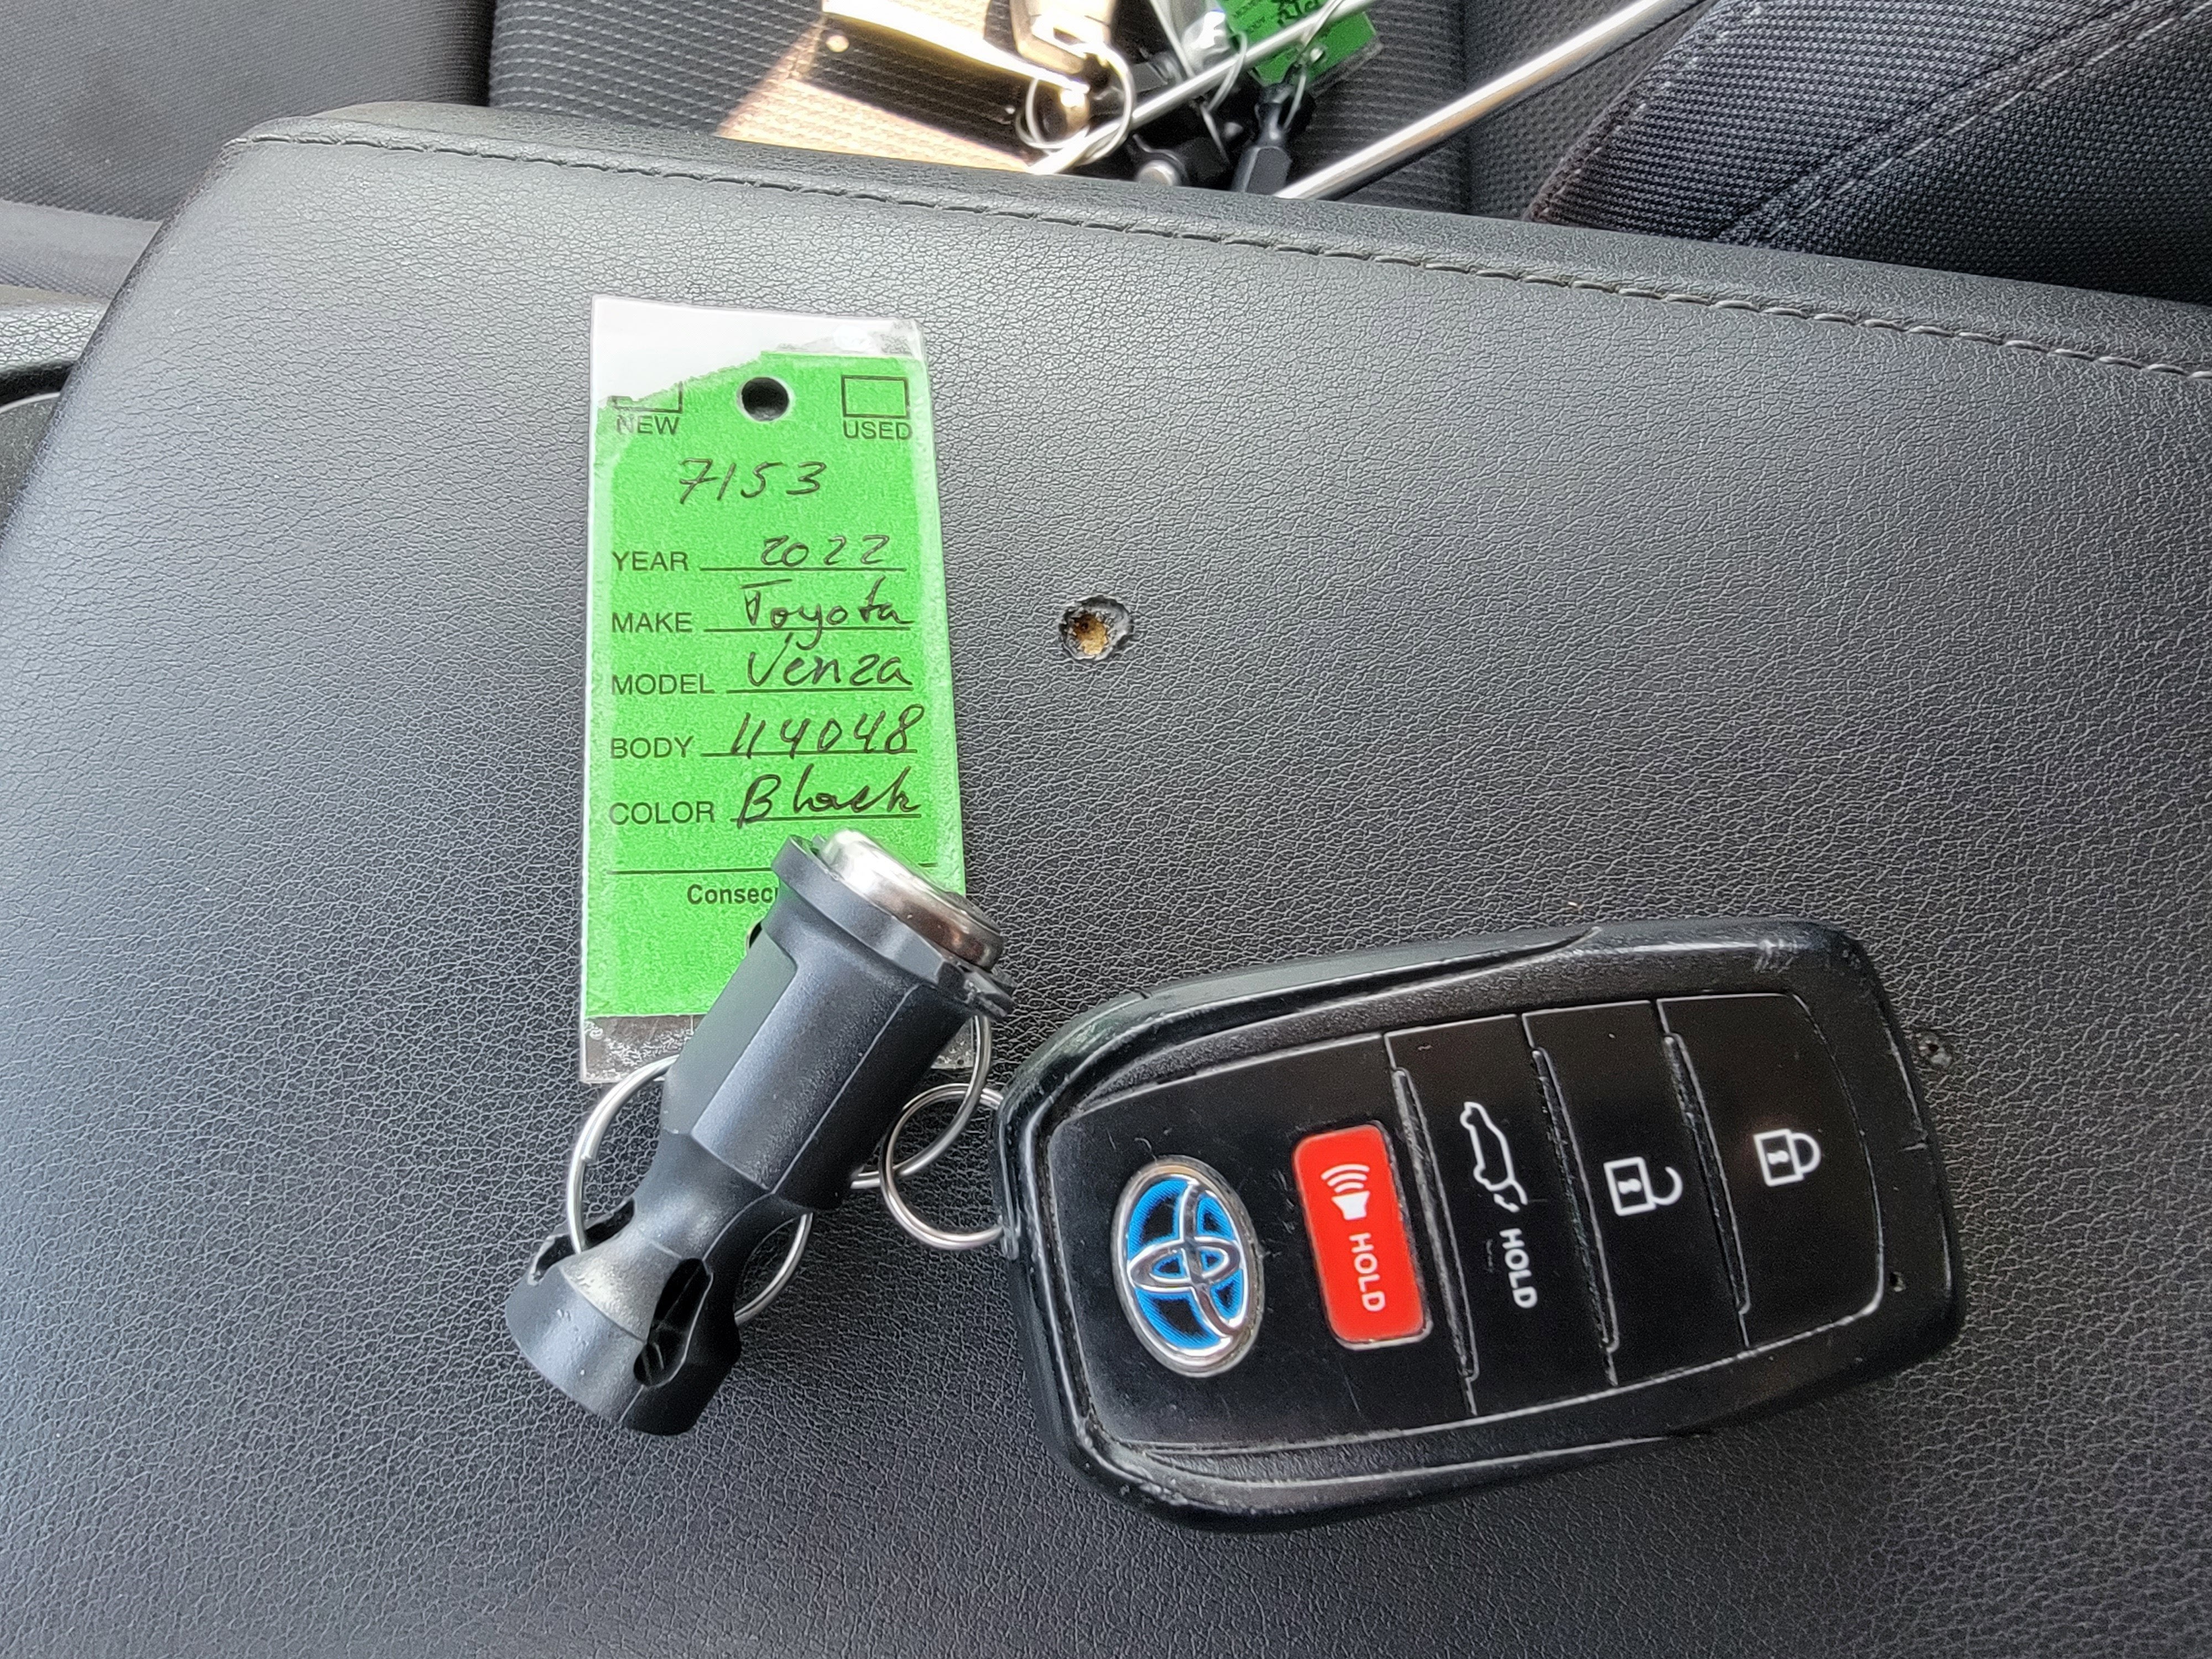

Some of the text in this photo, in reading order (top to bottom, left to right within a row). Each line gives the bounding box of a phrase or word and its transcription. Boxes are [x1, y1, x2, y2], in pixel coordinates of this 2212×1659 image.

[617, 414, 680, 435] NEW
[843, 421, 913, 440] USED
[679, 457, 827, 504] 7153
[612, 534, 890, 572] YEAR 2022
[611, 575, 915, 650] MAKE Toyota
[611, 632, 914, 695] MODEL Venza
[611, 703, 925, 760] BODY 114048
[610, 763, 922, 830] COLOR Black
[1349, 1232, 1386, 1312] HOLD
[1499, 1228, 1538, 1309] HOLD
